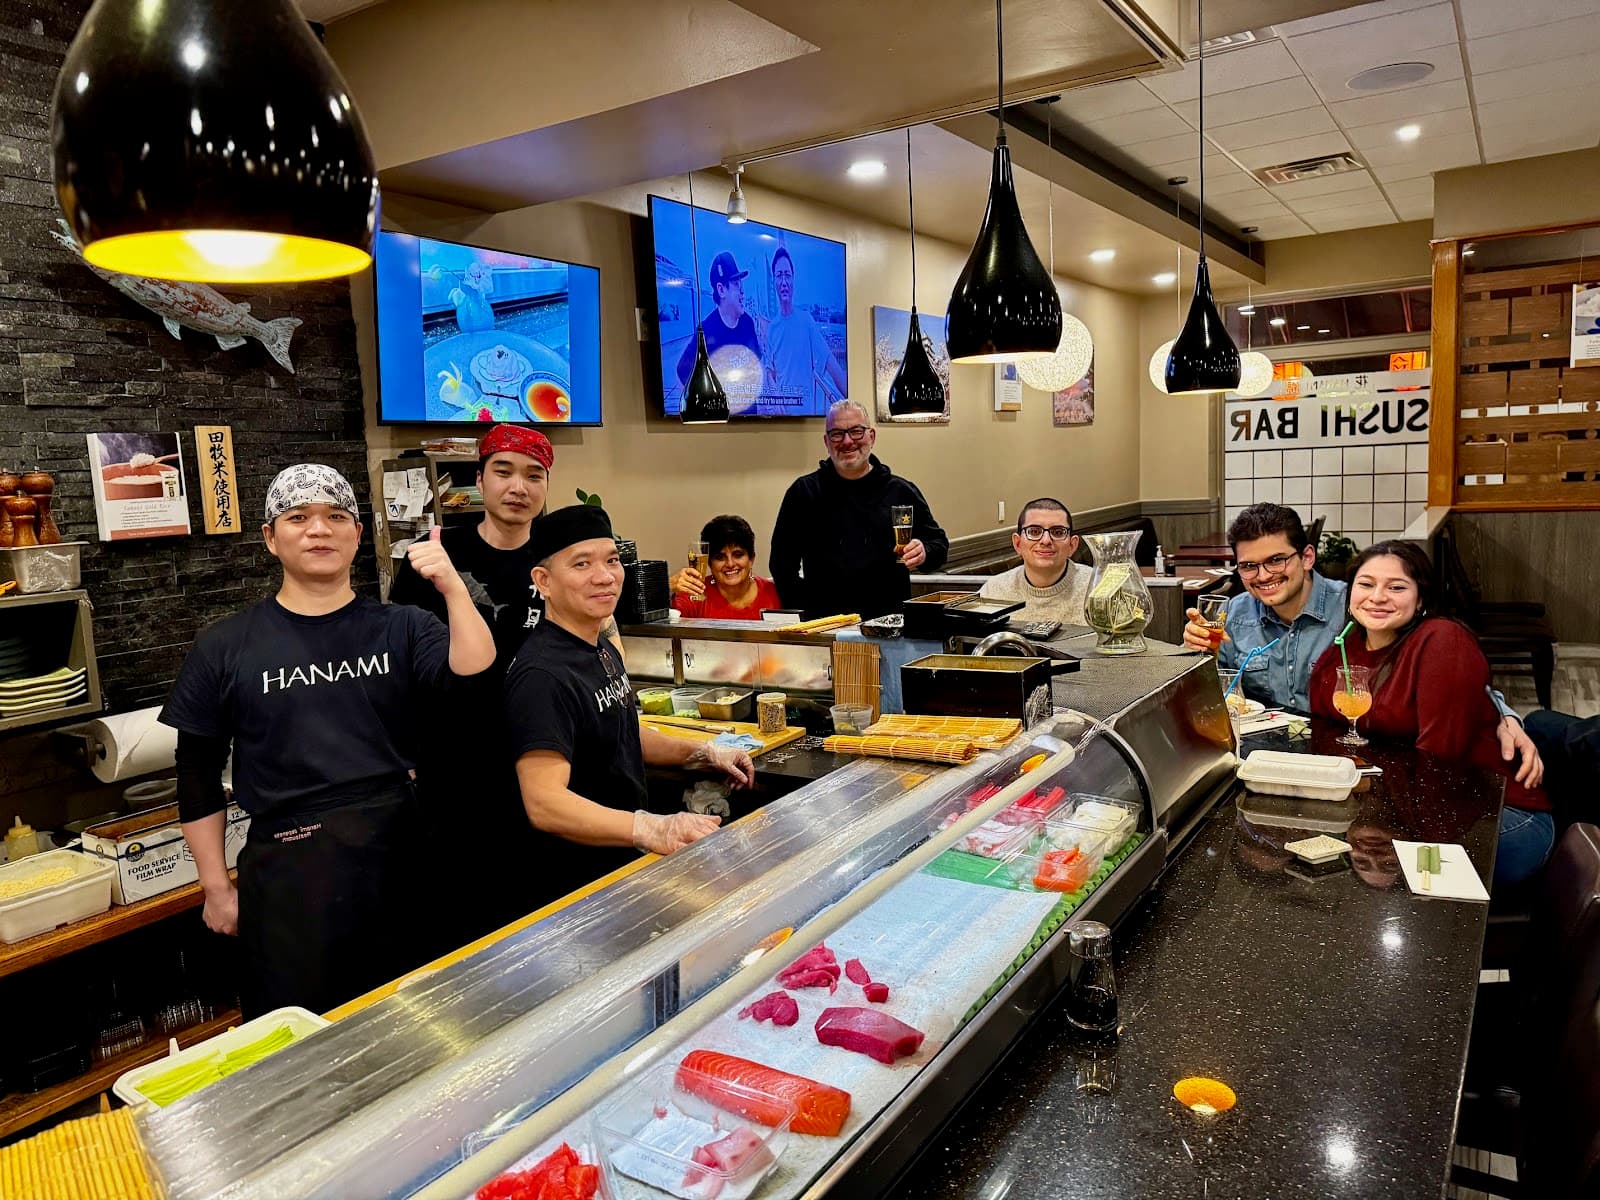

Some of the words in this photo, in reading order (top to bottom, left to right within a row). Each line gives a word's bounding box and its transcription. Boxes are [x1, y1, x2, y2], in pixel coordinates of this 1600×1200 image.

[208, 431, 232, 528] 田牧米使用店
[262, 652, 390, 694] HANAMI
[127, 862, 150, 876] FOOD
[151, 853, 181, 869] SERVICE
[136, 868, 154, 881] FILM
[155, 862, 177, 876] WRAP
